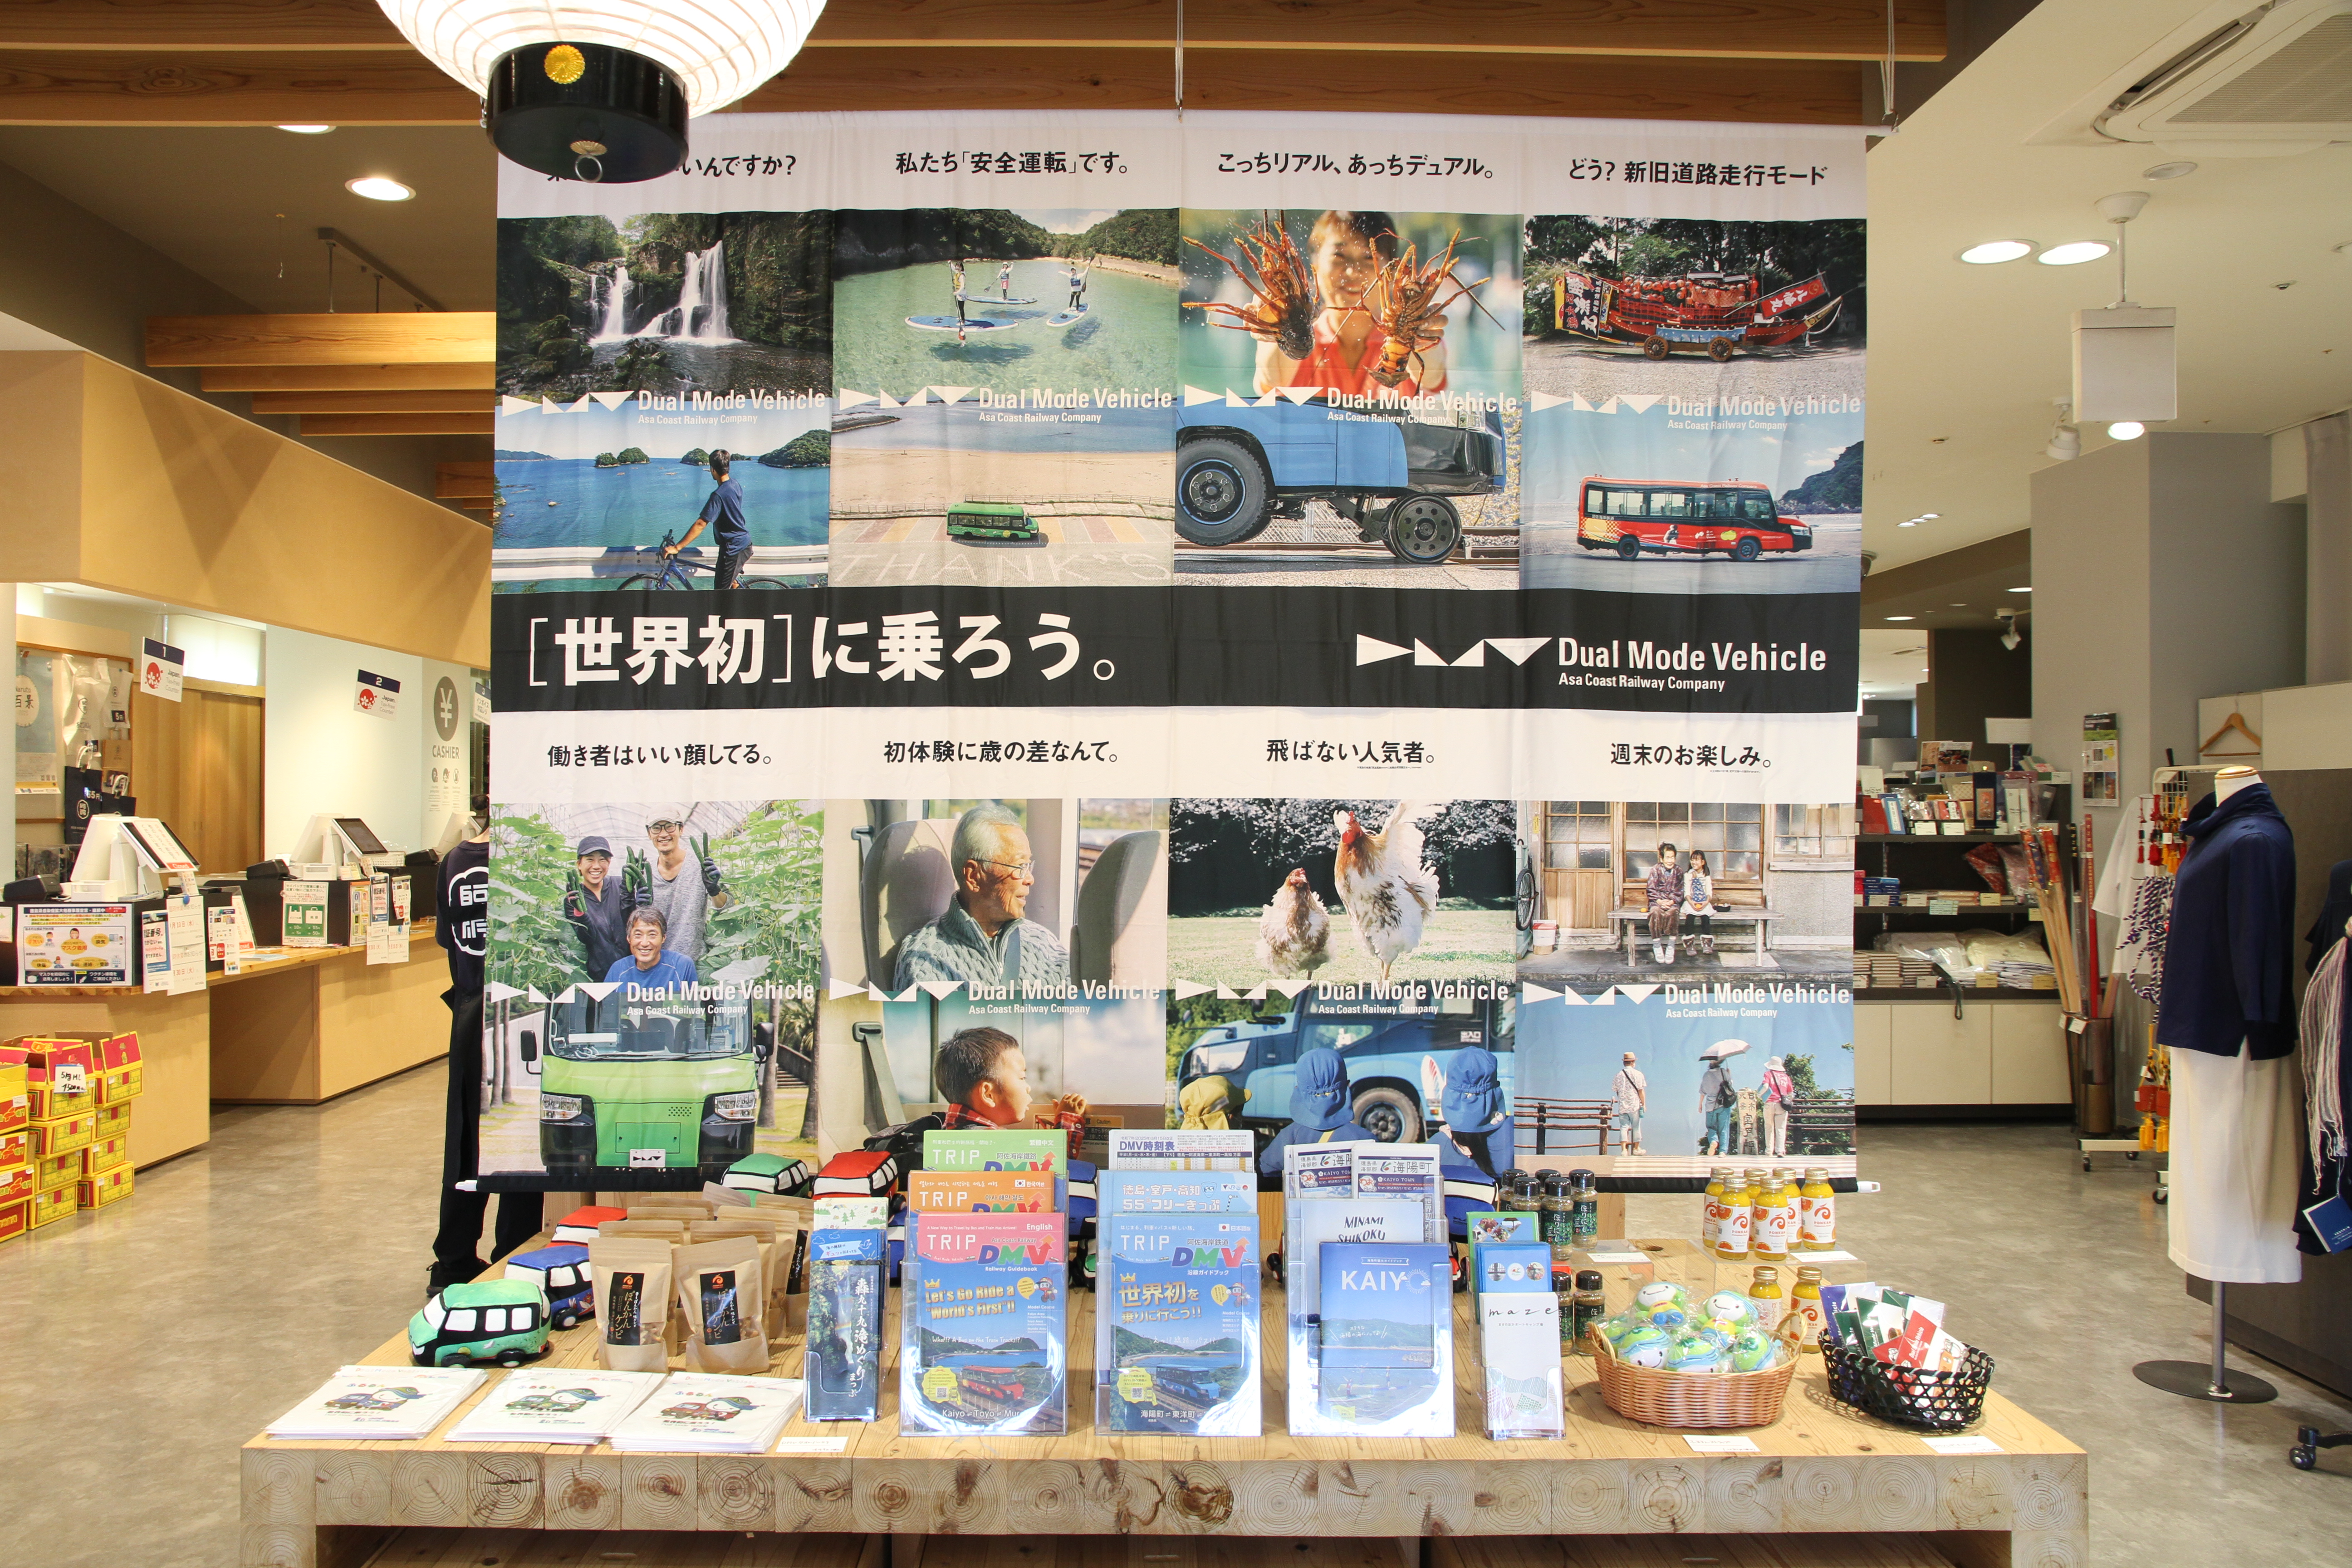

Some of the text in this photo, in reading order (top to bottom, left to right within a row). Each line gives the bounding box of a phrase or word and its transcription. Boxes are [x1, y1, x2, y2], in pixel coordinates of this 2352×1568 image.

[895, 151, 1127, 175] 私たち「安全運転」です。
[1218, 152, 1493, 179] こっちリアル、あっちデュアル。
[1624, 161, 1828, 186] 新旧道路走行モード
[639, 388, 826, 411] Dual Mode Vehicle
[979, 387, 1171, 409] Dual Mode Vehicle
[1328, 387, 1517, 412] Dual Mode Vehicle
[1668, 394, 1860, 416] Dual Mode Vehicle
[639, 413, 757, 426] Asa Coast Railway Company
[979, 412, 1101, 423] Asa Coast Railway Company
[1328, 412, 1447, 425] Asa Coast Railway Company
[1668, 420, 1787, 431] Asa Coast Railway Company
[162, 646, 166, 658] 1
[1558, 637, 1827, 672] Dual Mode Vehicle
[165, 685, 179, 694] Counter
[376, 677, 382, 686] 2
[1558, 673, 1725, 693] Asa Coast Railway Company
[379, 707, 394, 715] Counter
[432, 745, 460, 760] CASHIER
[548, 743, 771, 766] 働き者はいい顔してる。
[883, 740, 1117, 764] 初体験に歳の差なんて。
[1267, 739, 1435, 764] 飛ばない人気者。
[1611, 742, 1772, 768] 週末のお楽しみ。
[627, 979, 815, 1003] Dual Mode Vehicle
[969, 979, 1161, 1000] Dual Mode Vehicle
[1318, 980, 1509, 1001] Dual Mode Vehicle
[1665, 983, 1850, 1005] Dual Mode Vehicle
[627, 1004, 748, 1017] Asa Coast Railway Company
[969, 1004, 1091, 1015] Asa Coast Railway Company
[1318, 1004, 1439, 1015] Asa Coast Railway Company
[1666, 1007, 1778, 1019] Asa Coast Railway Company
[1120, 1141, 1175, 1151] DMV時刻表
[933, 1149, 980, 1164] TRIP
[1393, 1161, 1432, 1173] 海陽町
[919, 1191, 967, 1207] TRIP
[1123, 1185, 1200, 1196] 徳島・室戸・高知
[1344, 1216, 1383, 1229] MINAMI
[1553, 1214, 1561, 1242] ほりにし
[927, 1235, 976, 1250] TRIP
[1121, 1235, 1169, 1251] TRIP
[1187, 1238, 1229, 1246] 阿佐海岸鉄道
[1337, 1229, 1385, 1242] SHIKOKU
[977, 1242, 1053, 1265] DMV
[1171, 1246, 1247, 1268] DMV
[926, 1289, 954, 1303] Let's
[957, 1288, 973, 1301] Go
[976, 1286, 1004, 1299] Ride
[1007, 1286, 1014, 1297] a
[1118, 1281, 1199, 1307] 世界初を
[623, 1290, 635, 1329] ぽんかん
[718, 1289, 730, 1327] ぽんかん
[1489, 1307, 1559, 1318] maze
[615, 1314, 623, 1339] ケンピ
[712, 1314, 722, 1339] ケンピ
[848, 1372, 857, 1397] まっぷ
[1141, 1410, 1196, 1418] 海陽町 東洋町
